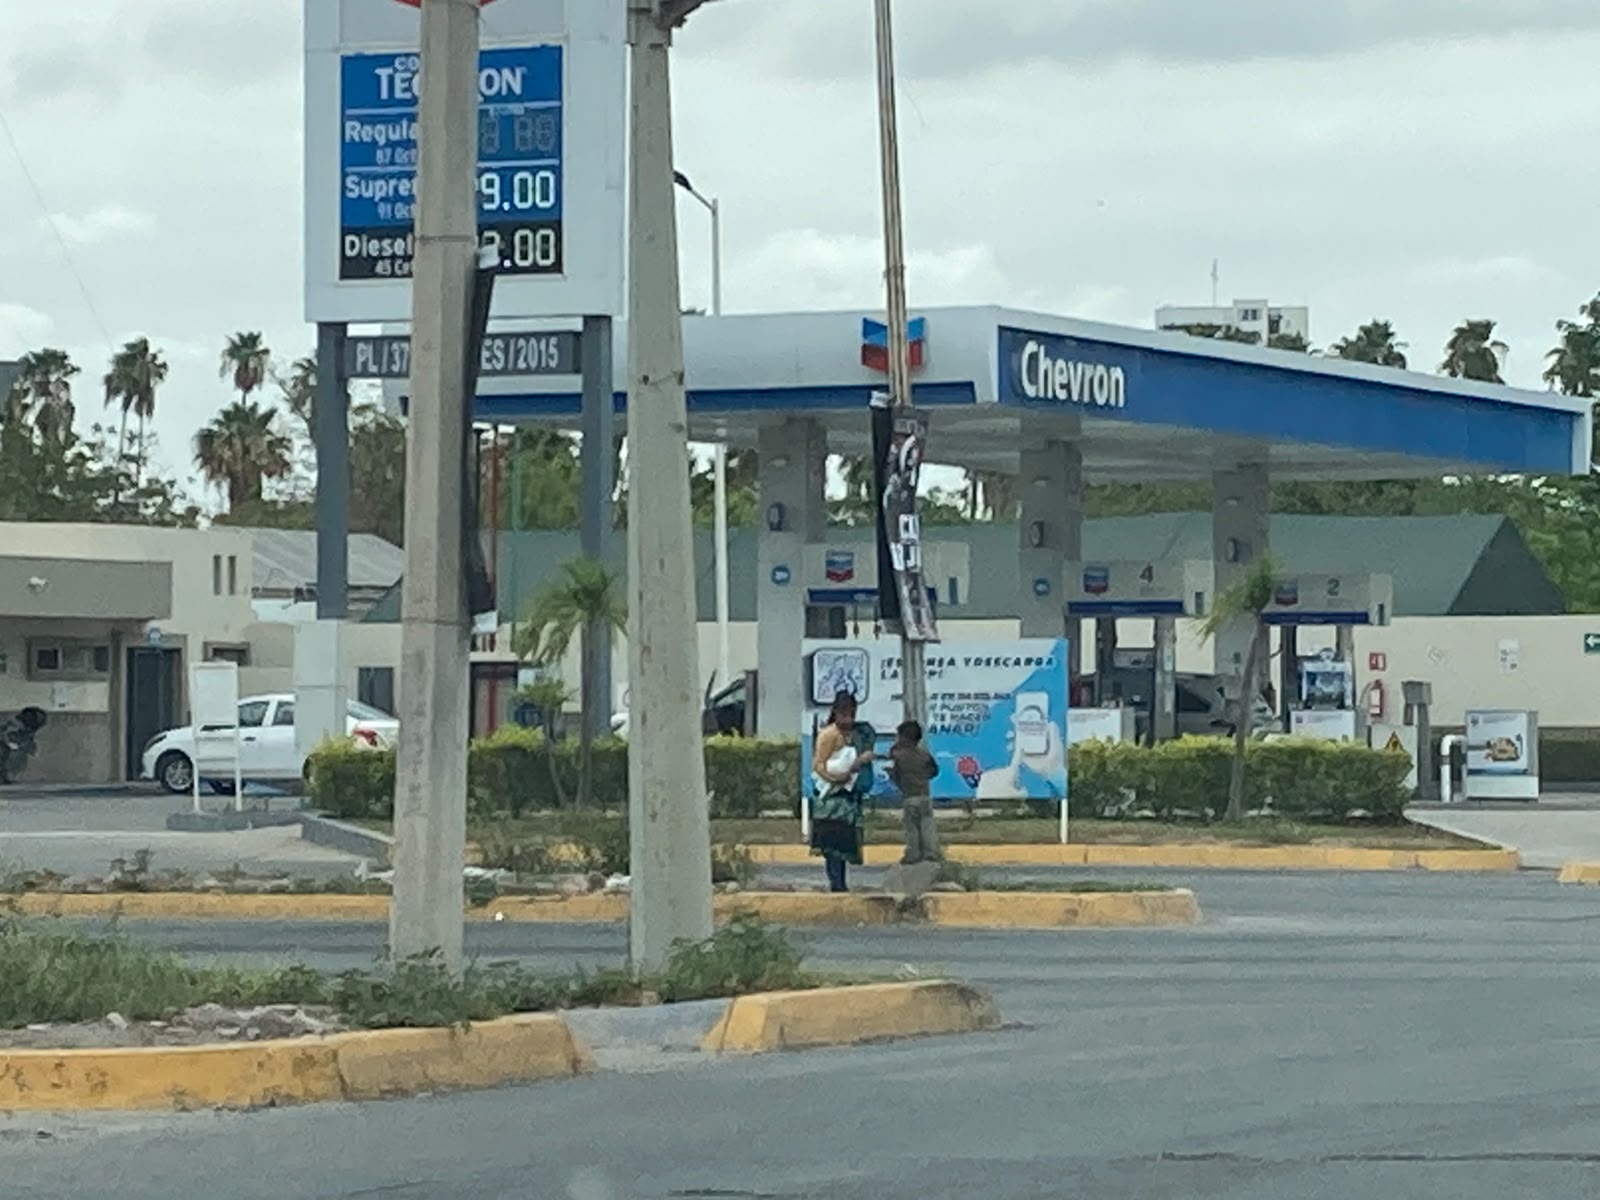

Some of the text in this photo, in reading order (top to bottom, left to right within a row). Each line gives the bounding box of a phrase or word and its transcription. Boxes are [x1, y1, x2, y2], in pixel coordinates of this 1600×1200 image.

[394, 56, 419, 71] CO
[344, 118, 417, 147] Regula
[344, 233, 414, 258] Diesel
[1021, 340, 1125, 408] Chevron
[1139, 565, 1154, 583] 4
[1327, 578, 1341, 596] 2
